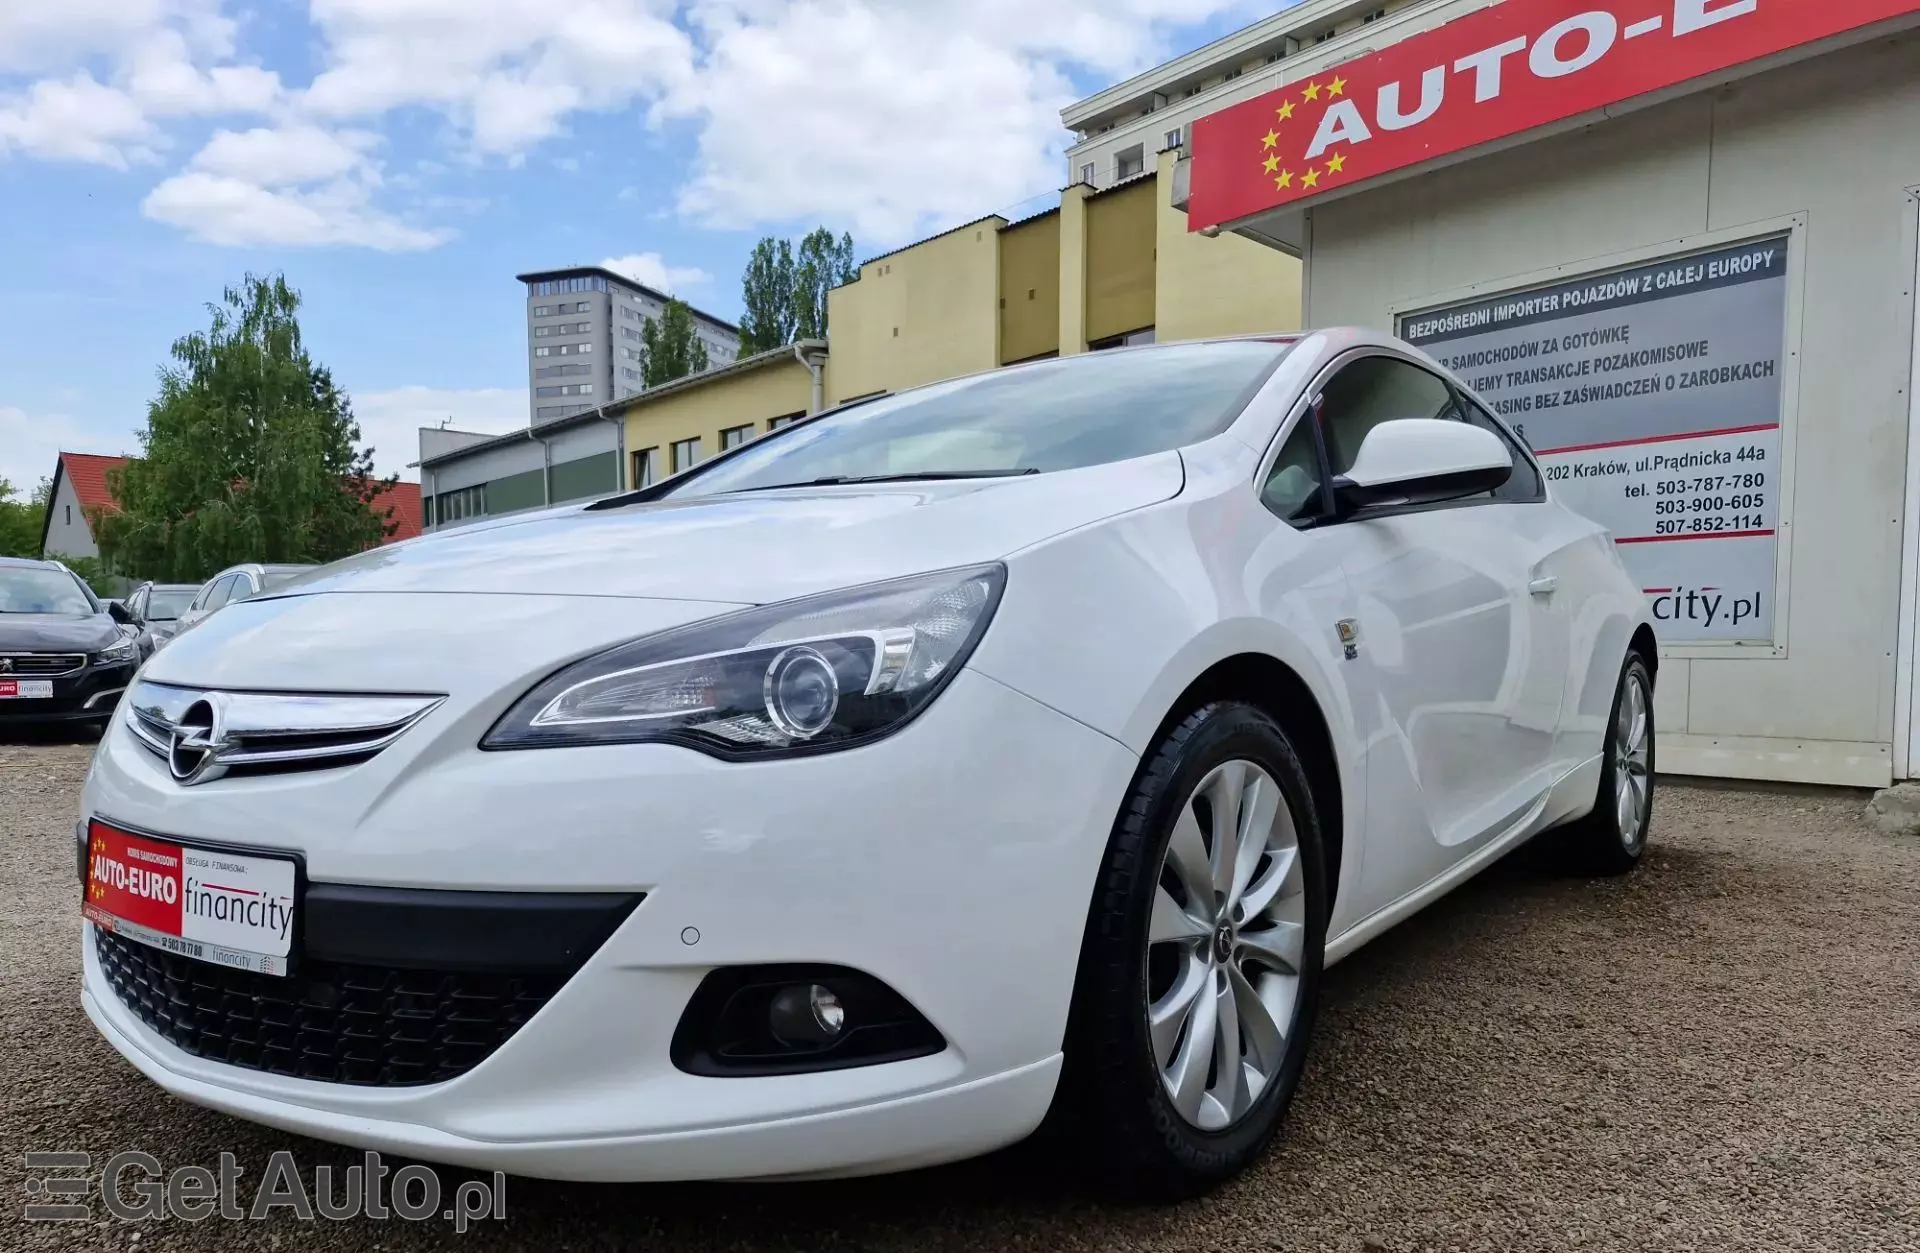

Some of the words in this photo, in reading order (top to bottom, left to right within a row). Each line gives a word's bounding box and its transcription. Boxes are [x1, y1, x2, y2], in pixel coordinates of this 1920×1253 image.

[1409, 309, 1490, 339] BEZPOŚREDNI
[1494, 295, 1559, 322] IMPORTER
[1563, 277, 1639, 308] POJAZDÓW
[1642, 275, 1653, 293] Z
[1656, 264, 1704, 289] CAŁEJ
[1708, 250, 1774, 279] EUROPY
[1452, 340, 1539, 370] SAMOCHODÓW
[1542, 338, 1559, 355] ZA
[1562, 325, 1630, 352] GOTÓWKĘ
[1506, 360, 1590, 387] TRANSAKCJE
[1593, 340, 1709, 374] POZAKOMISOWE
[1535, 392, 1561, 410] BEZ
[1563, 373, 1661, 406] ZAŚWIADCZEŃ
[1665, 375, 1675, 391] O
[1678, 360, 1775, 389] ZAROBKACH
[1573, 461, 1631, 478] Kraków,
[1635, 450, 1732, 472] ul.Prądnicka
[1736, 445, 1766, 462] 44a
[1624, 484, 1650, 498] tel.
[1656, 473, 1765, 495] 503-787-780
[1655, 493, 1764, 515] 503-900-605
[1655, 514, 1763, 534] 507-852-114
[94, 854, 177, 904] AUTO-EURO
[185, 877, 294, 940] financity
[212, 945, 251, 970] financity
